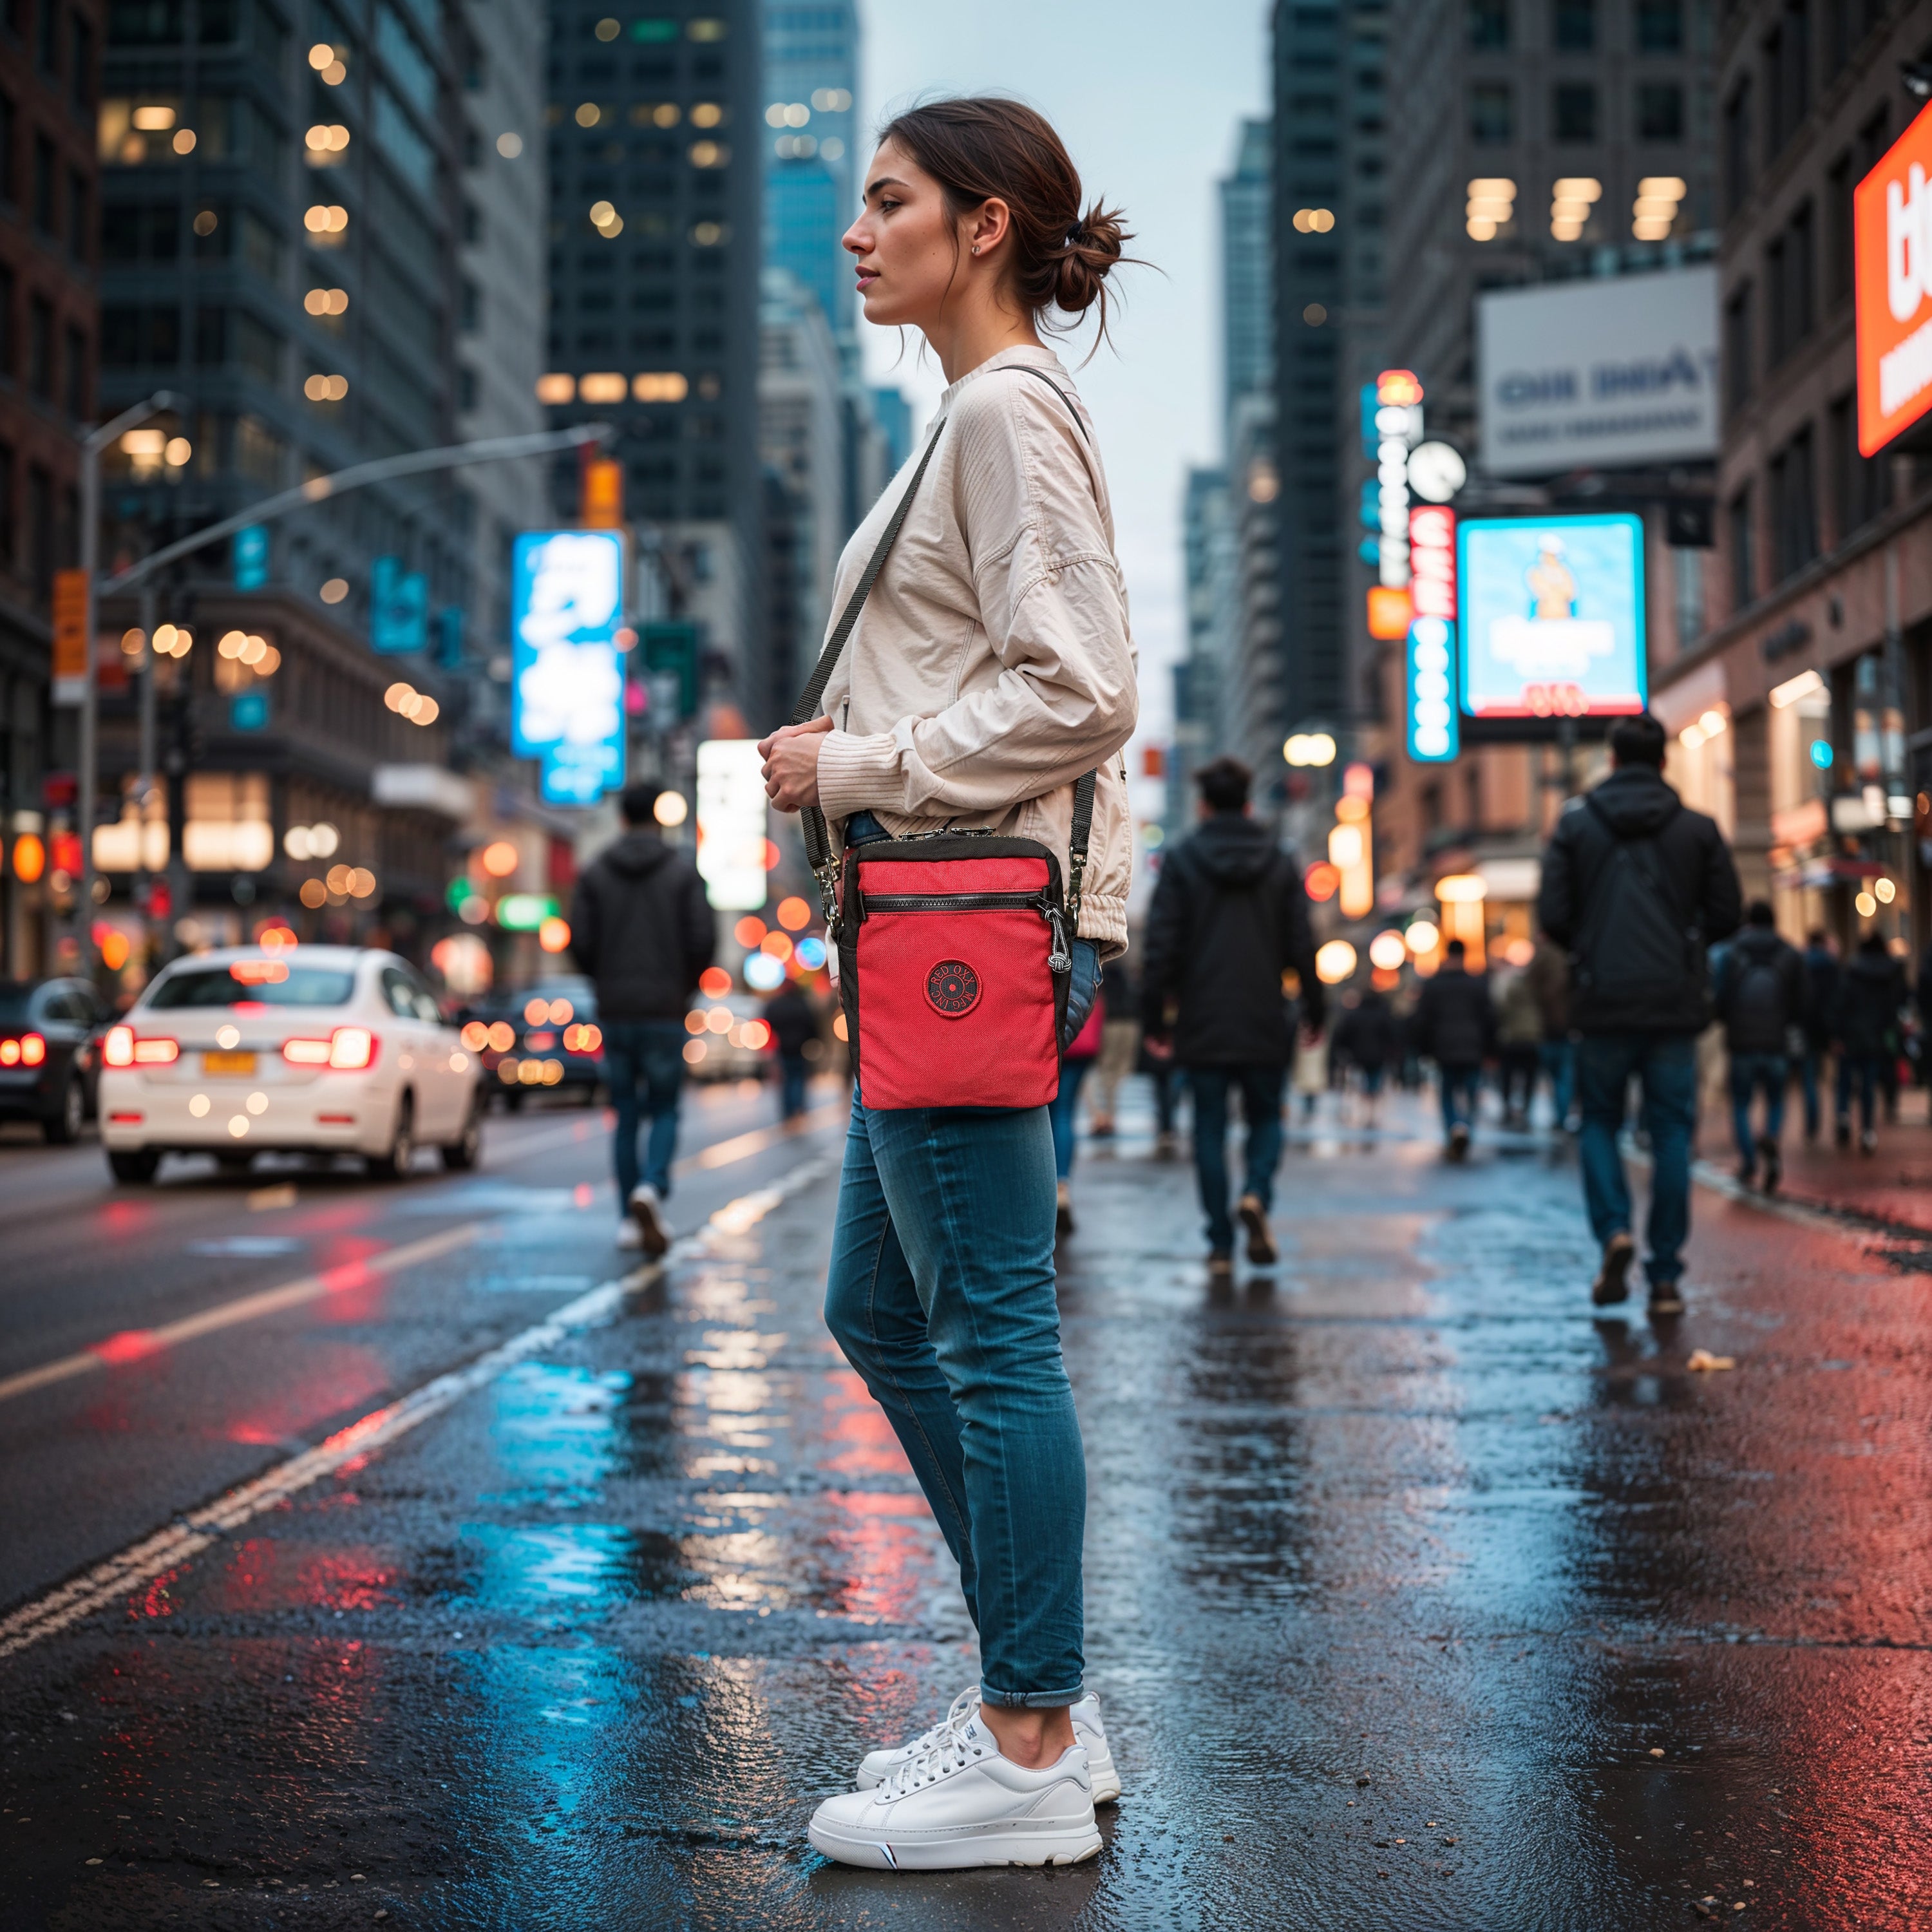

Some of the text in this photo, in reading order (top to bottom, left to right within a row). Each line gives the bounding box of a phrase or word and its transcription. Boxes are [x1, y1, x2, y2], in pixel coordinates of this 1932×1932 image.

[931, 965, 975, 1010] RED OXX MFG INC
